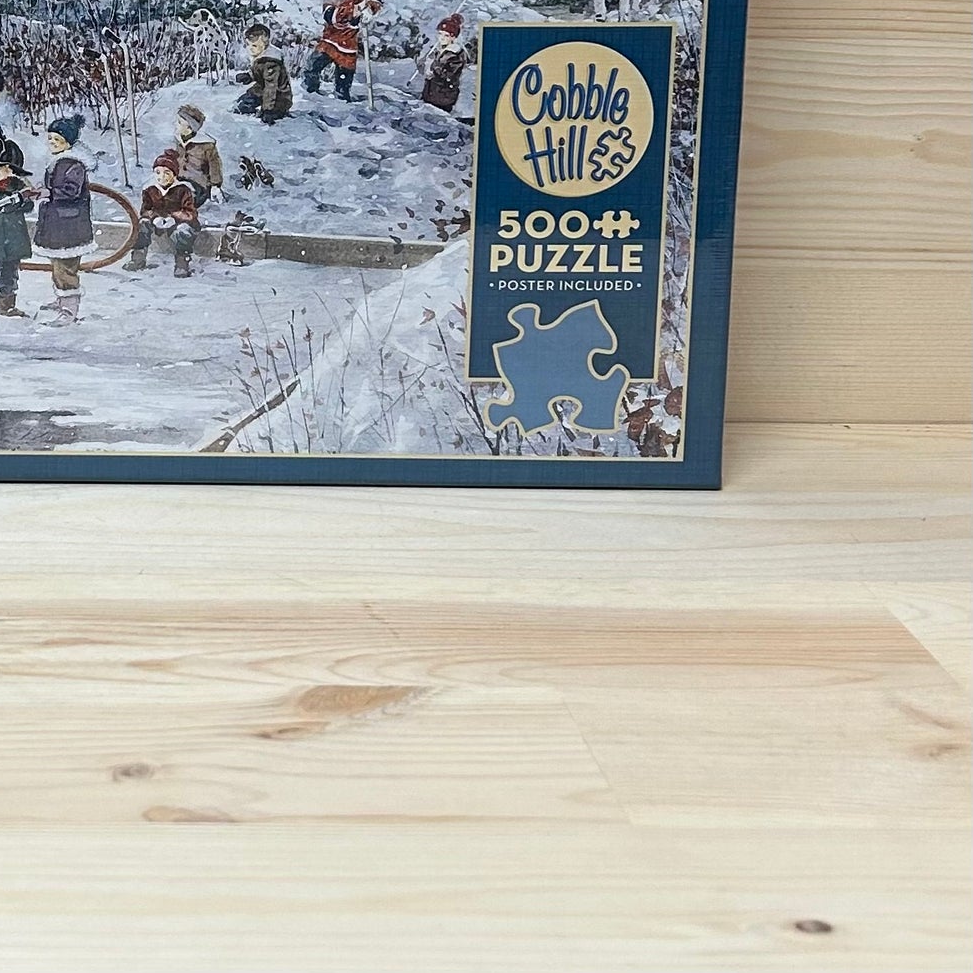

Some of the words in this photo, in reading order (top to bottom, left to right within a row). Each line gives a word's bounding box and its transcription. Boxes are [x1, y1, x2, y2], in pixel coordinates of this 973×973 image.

[512, 63, 629, 125] Cobble
[524, 125, 587, 187] Hill
[498, 211, 589, 239] 500
[489, 244, 643, 273] PUZZLE
[498, 280, 554, 291] POSTER
[559, 280, 633, 291] INCLUDED
